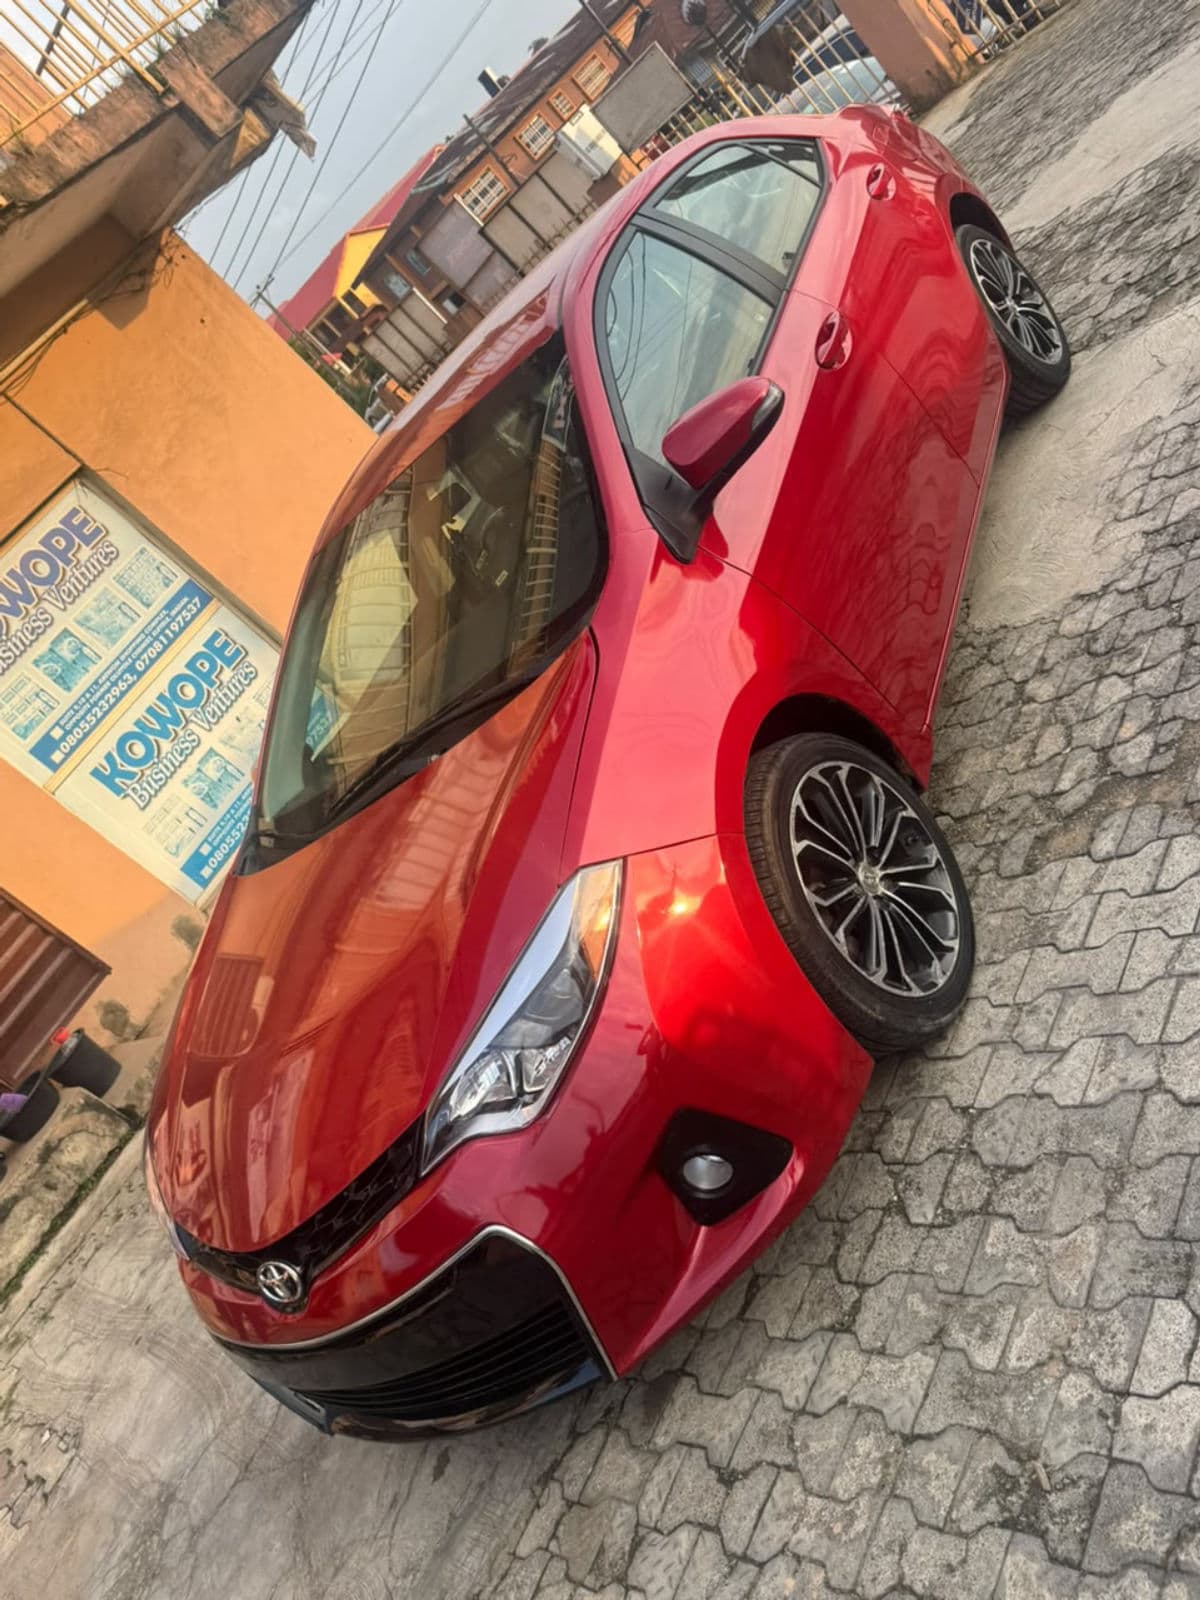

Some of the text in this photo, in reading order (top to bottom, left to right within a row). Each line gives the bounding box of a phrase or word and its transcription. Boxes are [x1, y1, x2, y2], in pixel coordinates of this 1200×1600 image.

[42, 539, 118, 611] Ventures
[59, 597, 202, 754] 08055232963, 07081197537
[89, 629, 247, 798] KOWOPE
[128, 660, 257, 808] Business Ventures
